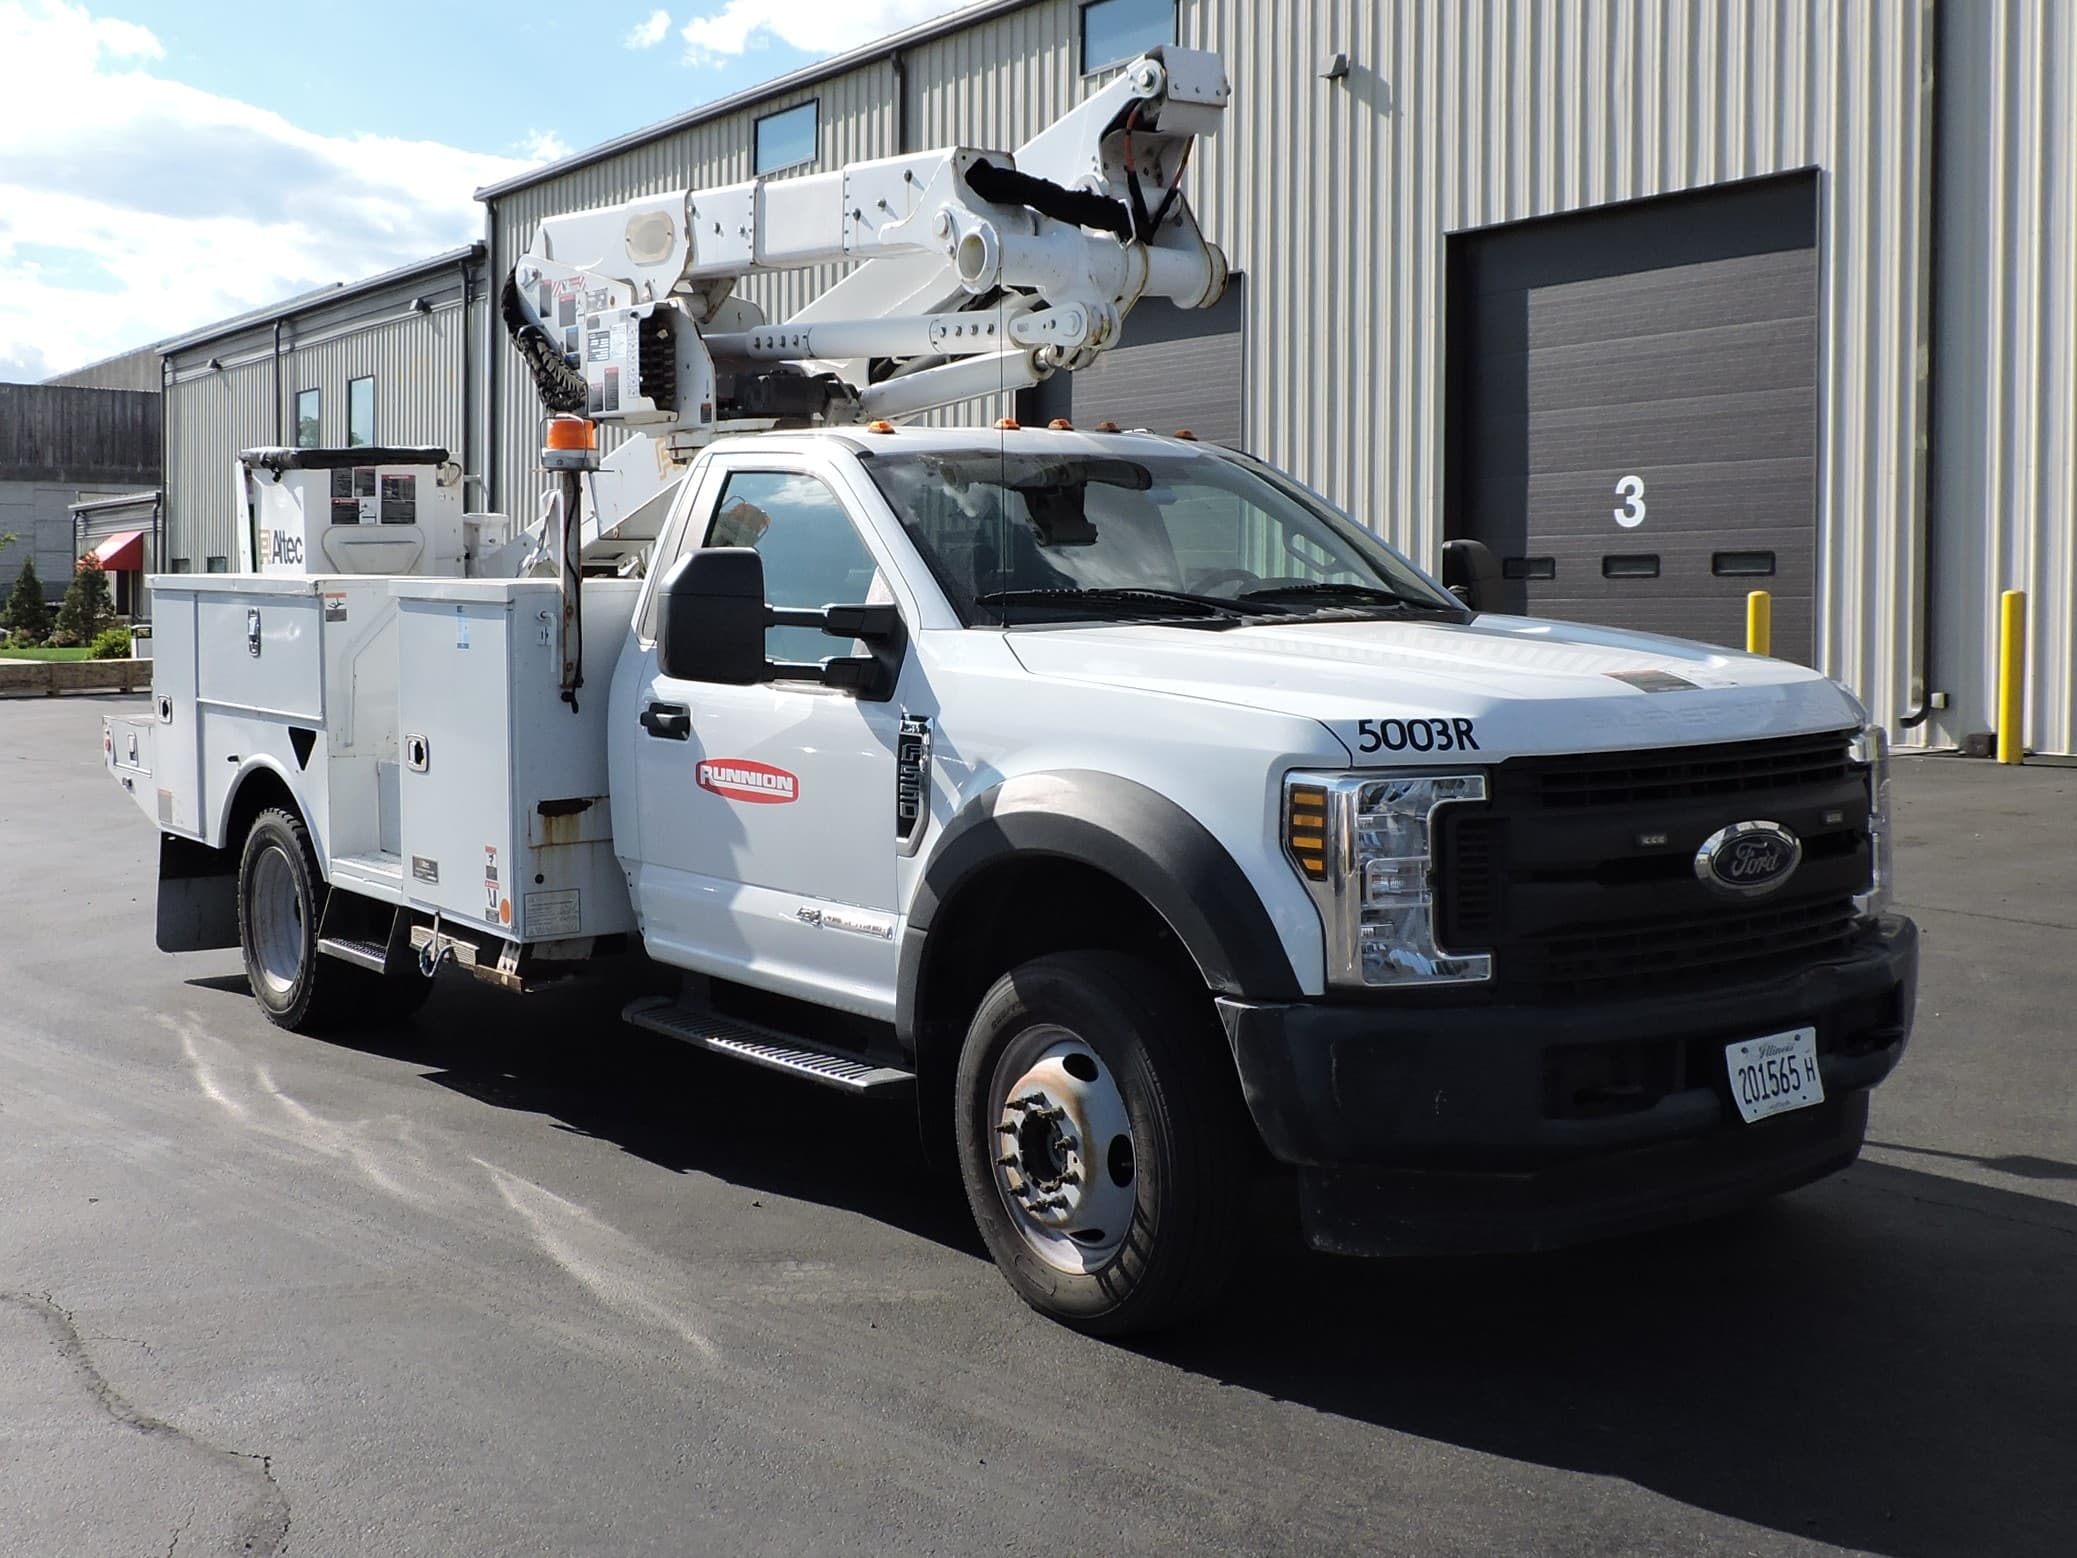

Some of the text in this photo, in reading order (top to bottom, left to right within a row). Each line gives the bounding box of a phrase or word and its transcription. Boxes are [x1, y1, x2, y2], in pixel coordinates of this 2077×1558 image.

[1614, 475, 1646, 528] 3
[272, 530, 303, 564] Altec
[1358, 717, 1480, 752] 5003R
[700, 764, 794, 793] RUNNION
[1731, 841, 1779, 877] Ford
[1738, 1055, 1816, 1105] 201565 H
